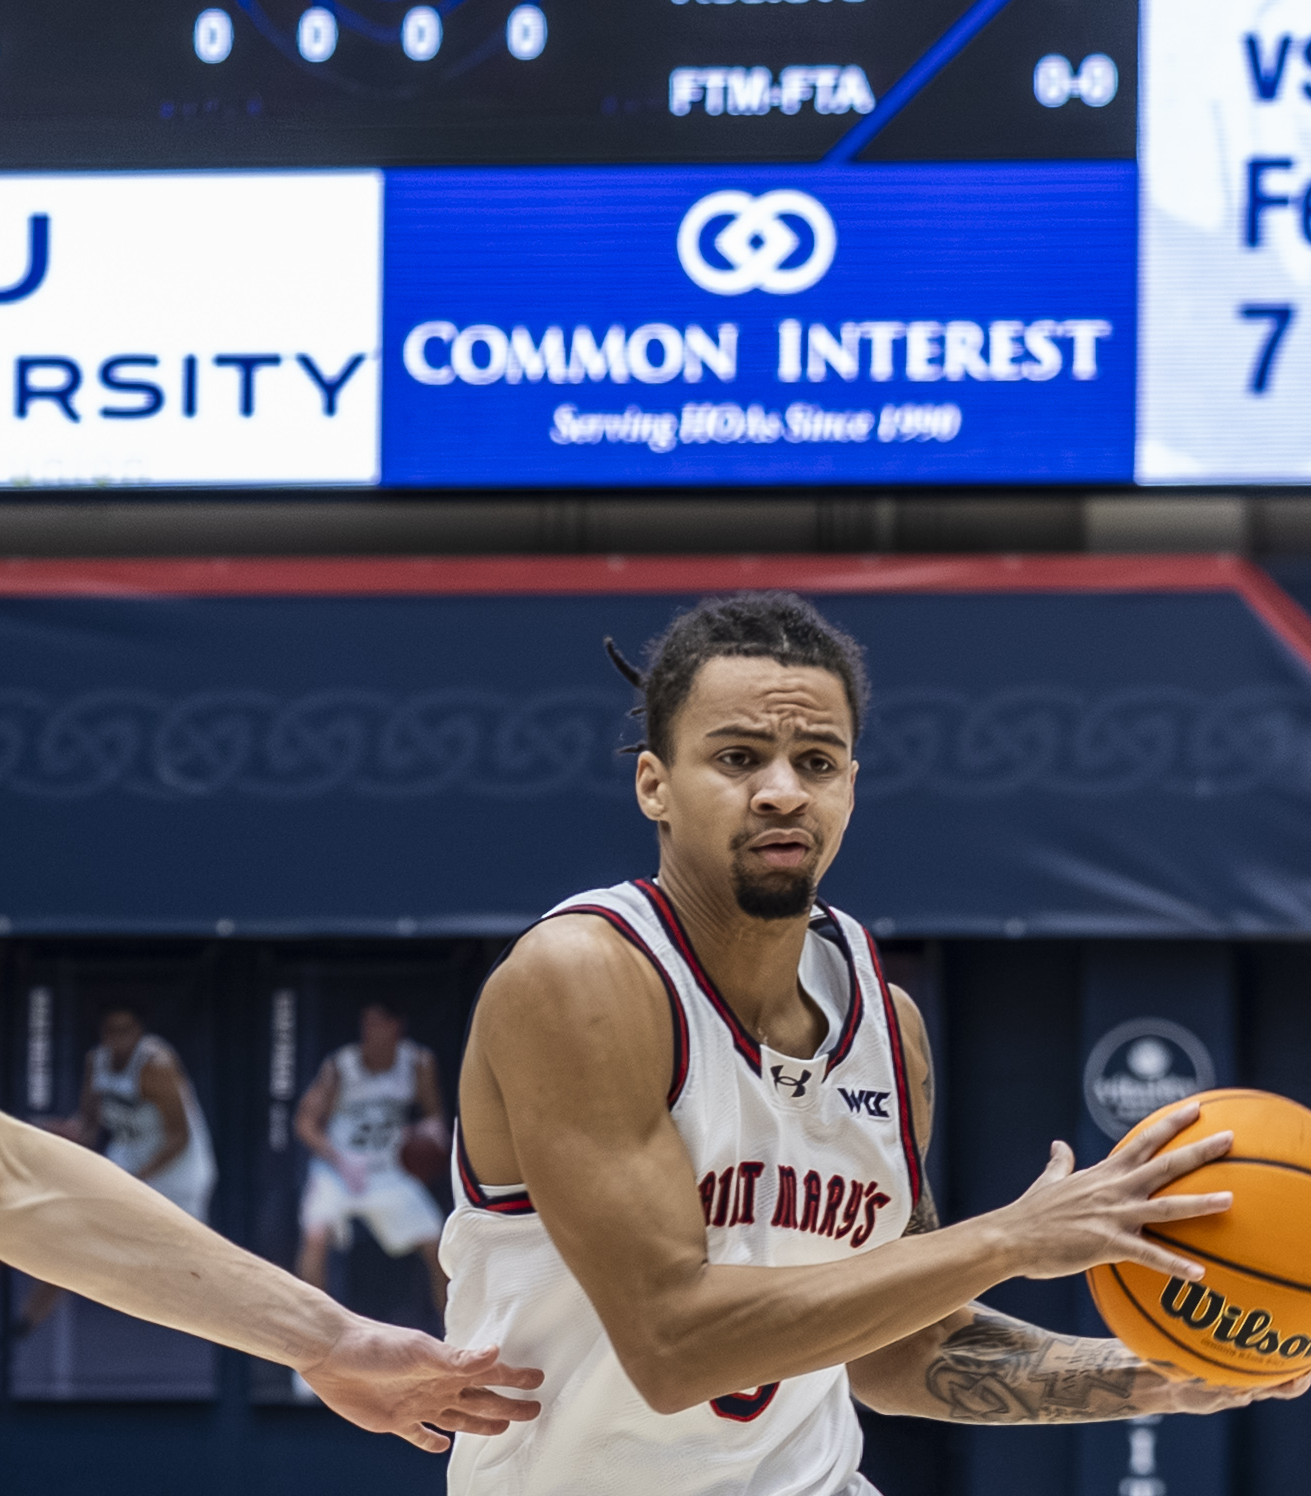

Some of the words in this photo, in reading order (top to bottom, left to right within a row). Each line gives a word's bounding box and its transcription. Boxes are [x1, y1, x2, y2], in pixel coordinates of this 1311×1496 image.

[193, 7, 234, 64] 0
[296, 6, 338, 63] 0
[400, 5, 443, 62] 0
[505, 4, 548, 61] 0
[669, 64, 876, 117] FTM-FTA
[1033, 52, 1119, 108] 0-0
[402, 320, 739, 386] COMMON
[777, 318, 1113, 384] INTEREST
[1239, 302, 1296, 396] 7
[549, 403, 678, 454] Serving
[784, 401, 876, 443] Since
[837, 1087, 891, 1118] WCC
